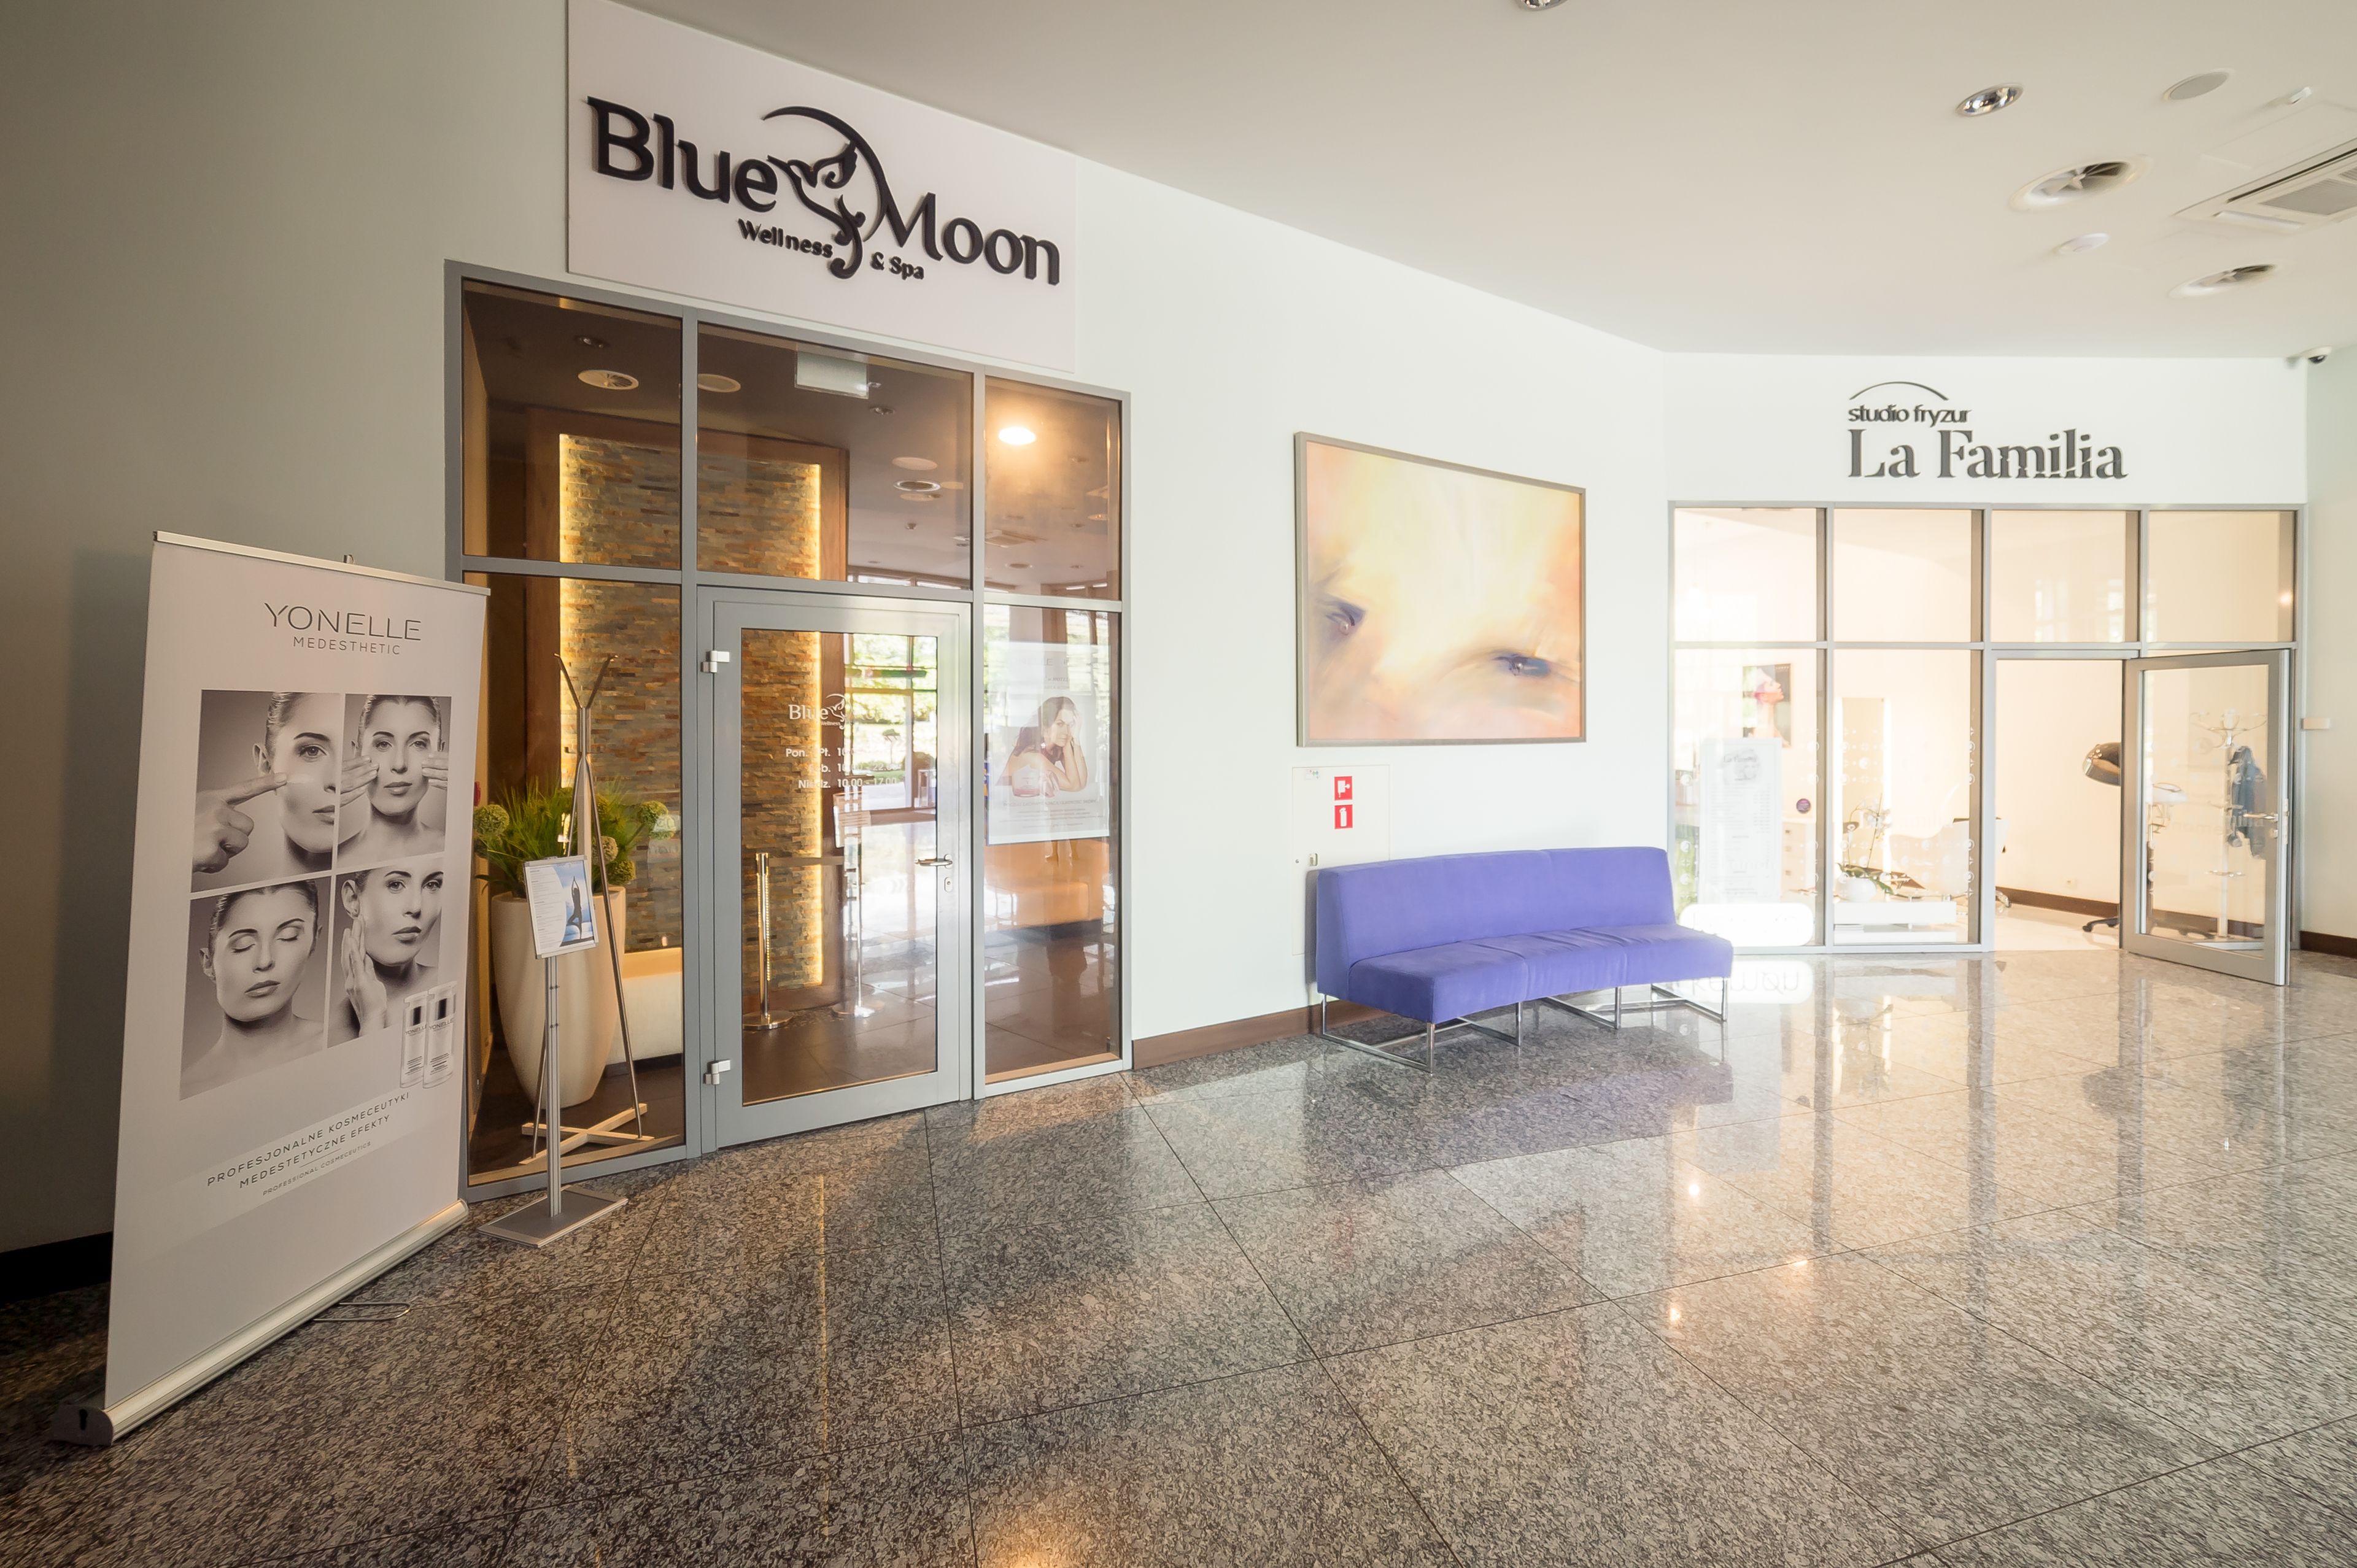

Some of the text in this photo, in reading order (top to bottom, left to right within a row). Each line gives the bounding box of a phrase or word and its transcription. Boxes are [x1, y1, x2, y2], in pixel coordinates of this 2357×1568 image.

[587, 96, 1061, 286] Blue Moon
[737, 218, 924, 280] Wellness & Spa
[1848, 404, 1972, 427] studio fryzur
[1848, 428, 2129, 479] La Familia
[265, 602, 422, 641] YONELLE
[293, 636, 401, 655] MEDESTHETIC
[785, 747, 808, 757] Pon.
[873, 777, 897, 786] 1700
[207, 1092, 409, 1186] PROFESJONALNE KOSMECEUTYKI
[239, 1114, 390, 1188] MEDESTETYCZNE EFEKTY
[263, 1141, 371, 1196] PROFESSIONAL COSMECEUTICS
